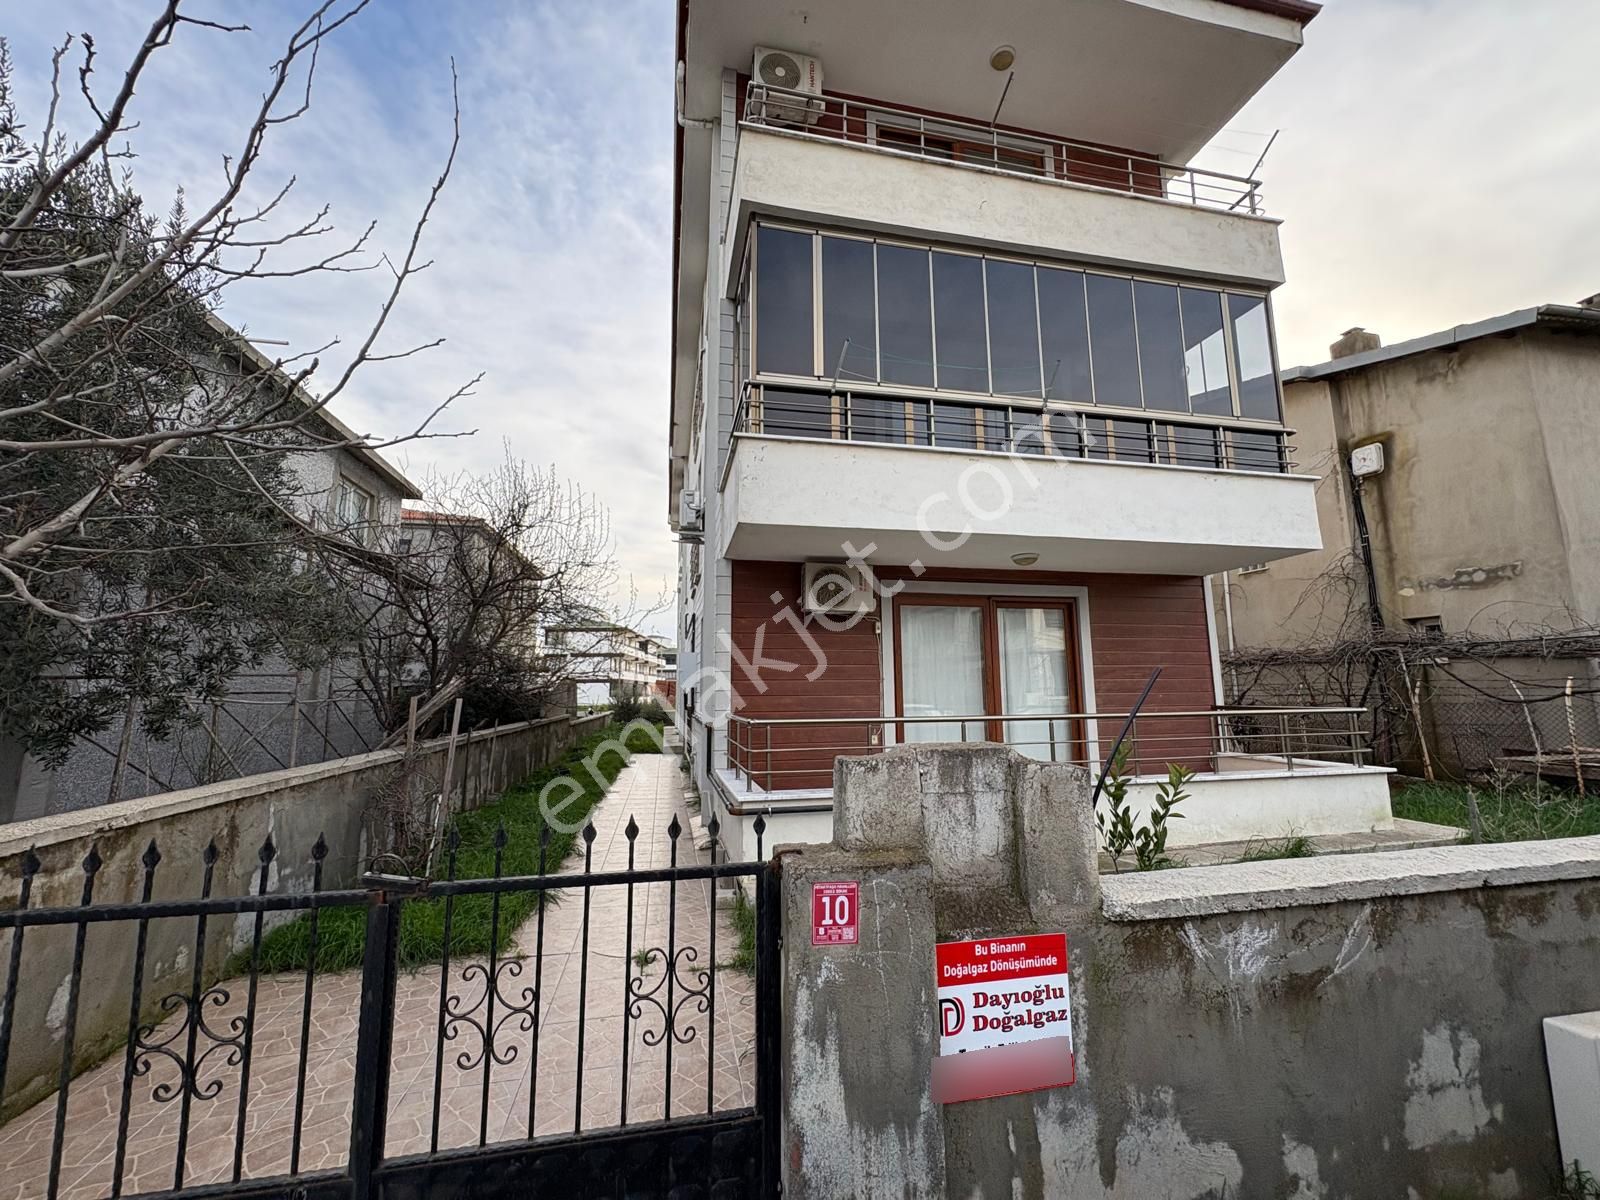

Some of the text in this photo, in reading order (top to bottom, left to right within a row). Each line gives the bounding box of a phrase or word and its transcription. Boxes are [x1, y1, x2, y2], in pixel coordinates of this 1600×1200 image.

[821, 895, 849, 925] 10
[975, 942, 1026, 956] Bu Binanın
[944, 955, 1057, 979] Doğalgaz Dönüşümünde
[973, 984, 1065, 1010] Dayıoğlu
[973, 1008, 1068, 1034] Doğalgaz
